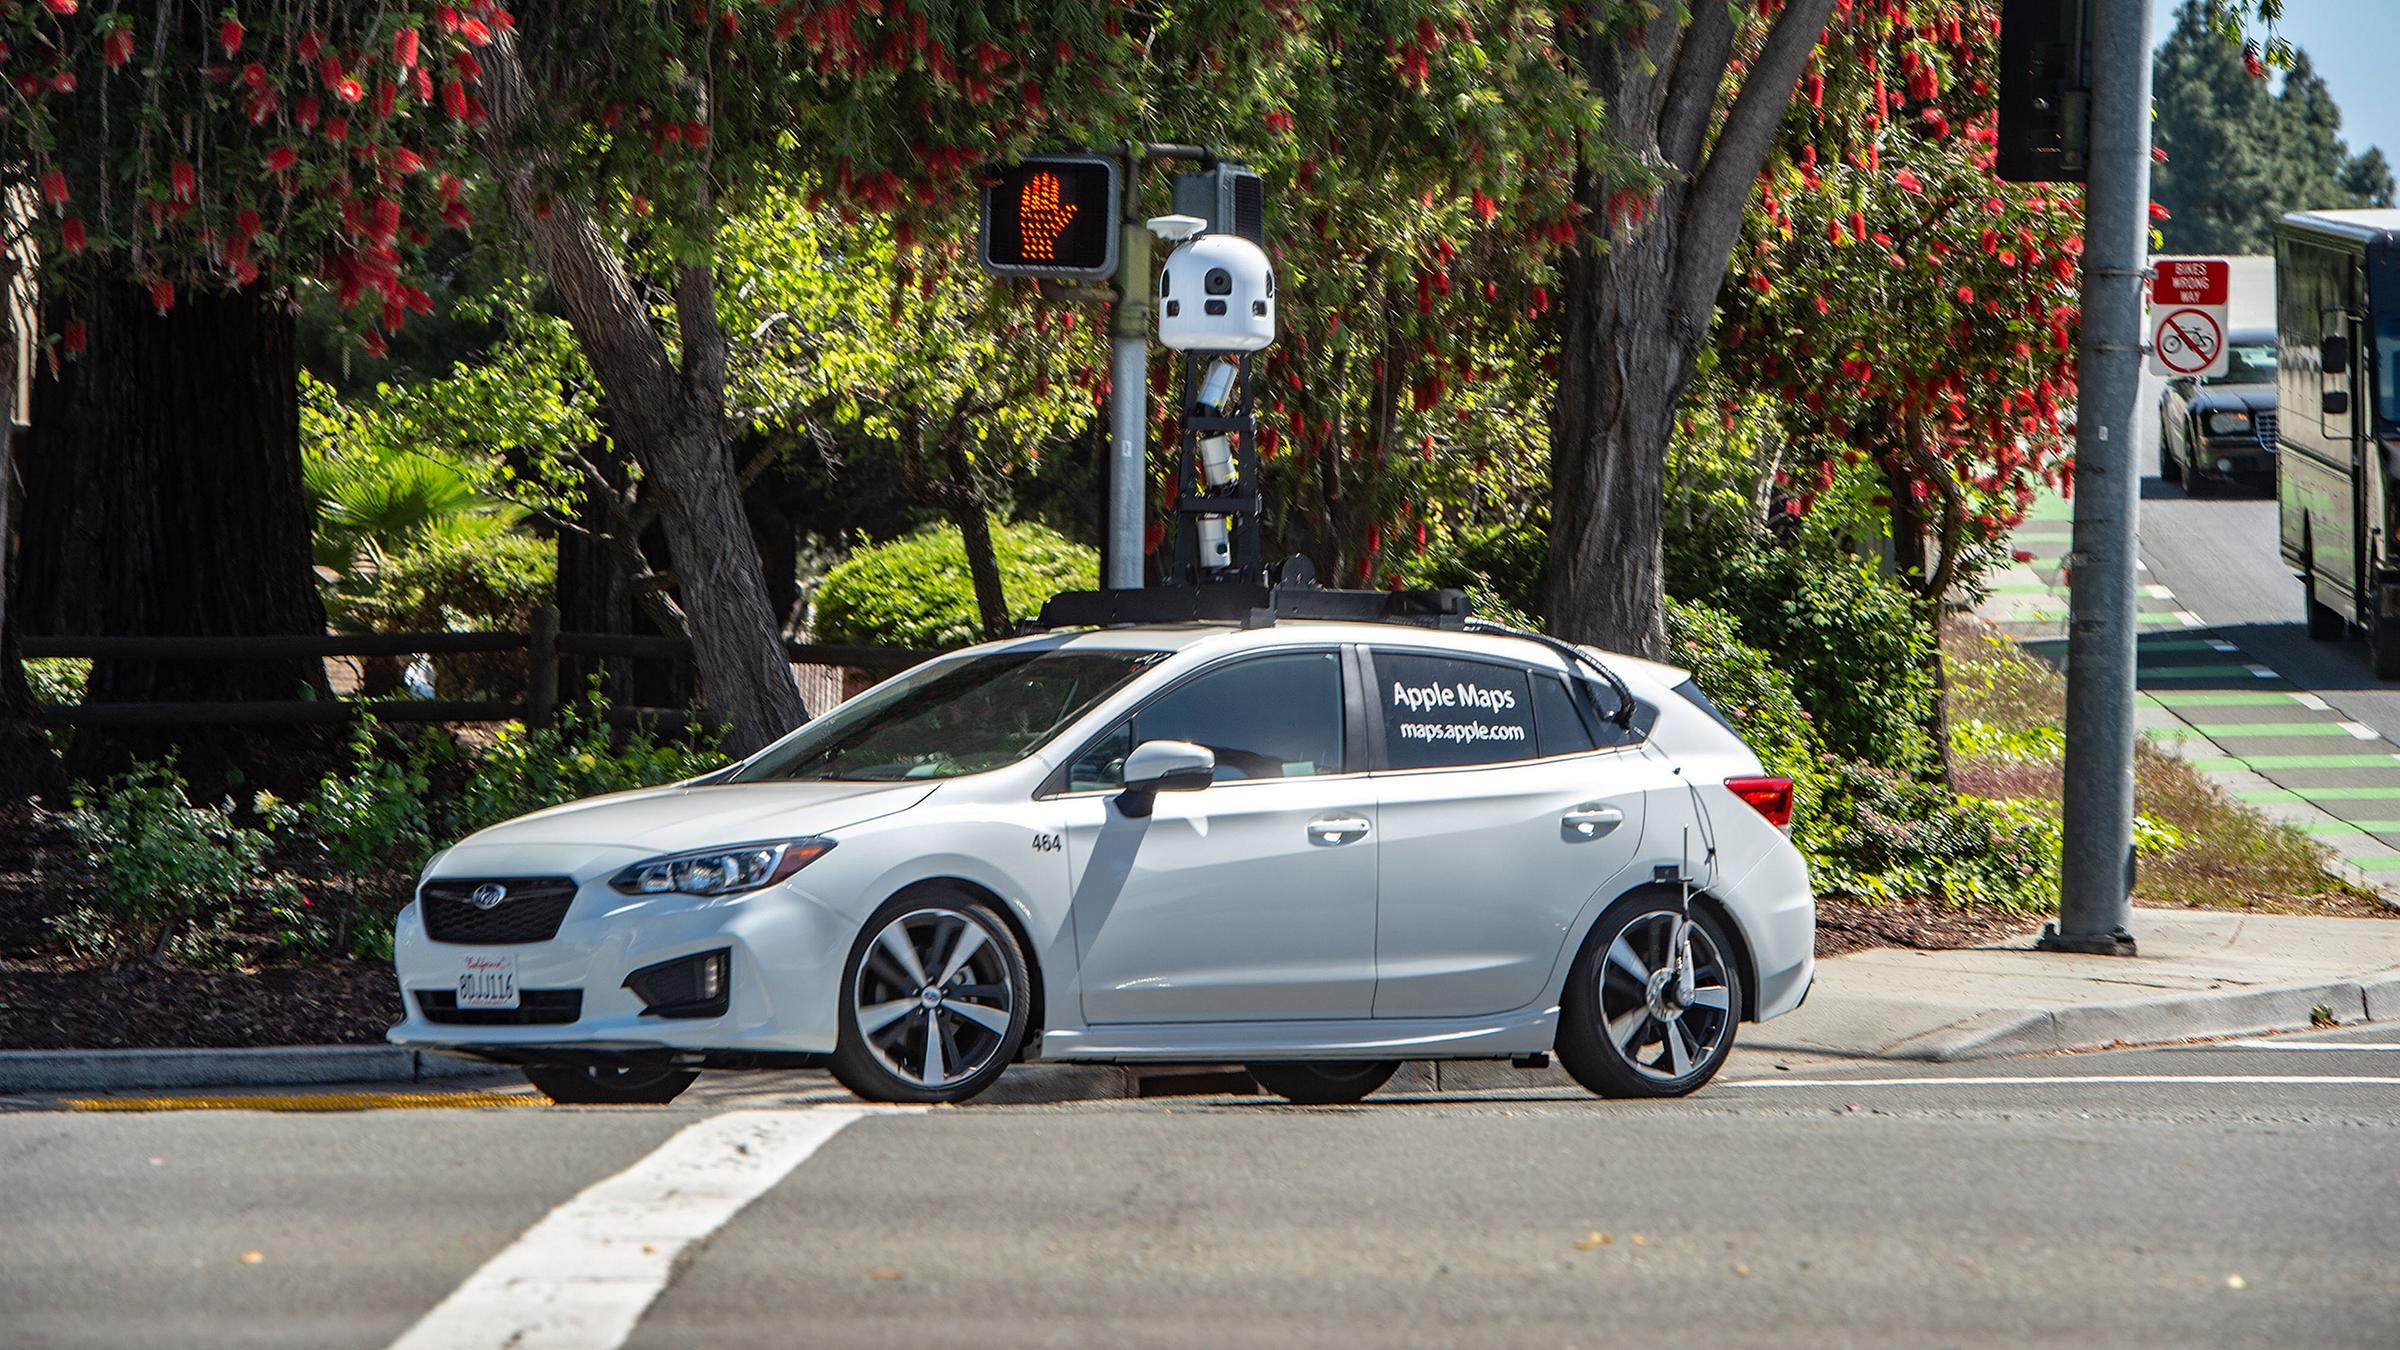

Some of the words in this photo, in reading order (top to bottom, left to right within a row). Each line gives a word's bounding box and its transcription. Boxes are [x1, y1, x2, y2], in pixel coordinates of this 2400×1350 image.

[2175, 263, 2207, 276] BIKES
[2172, 277, 2210, 289] WRONG
[2180, 290, 2201, 303] WAY
[1394, 681, 1456, 712] Apple
[1456, 683, 1516, 714] Maps
[1400, 720, 1525, 744] maps.apple.com
